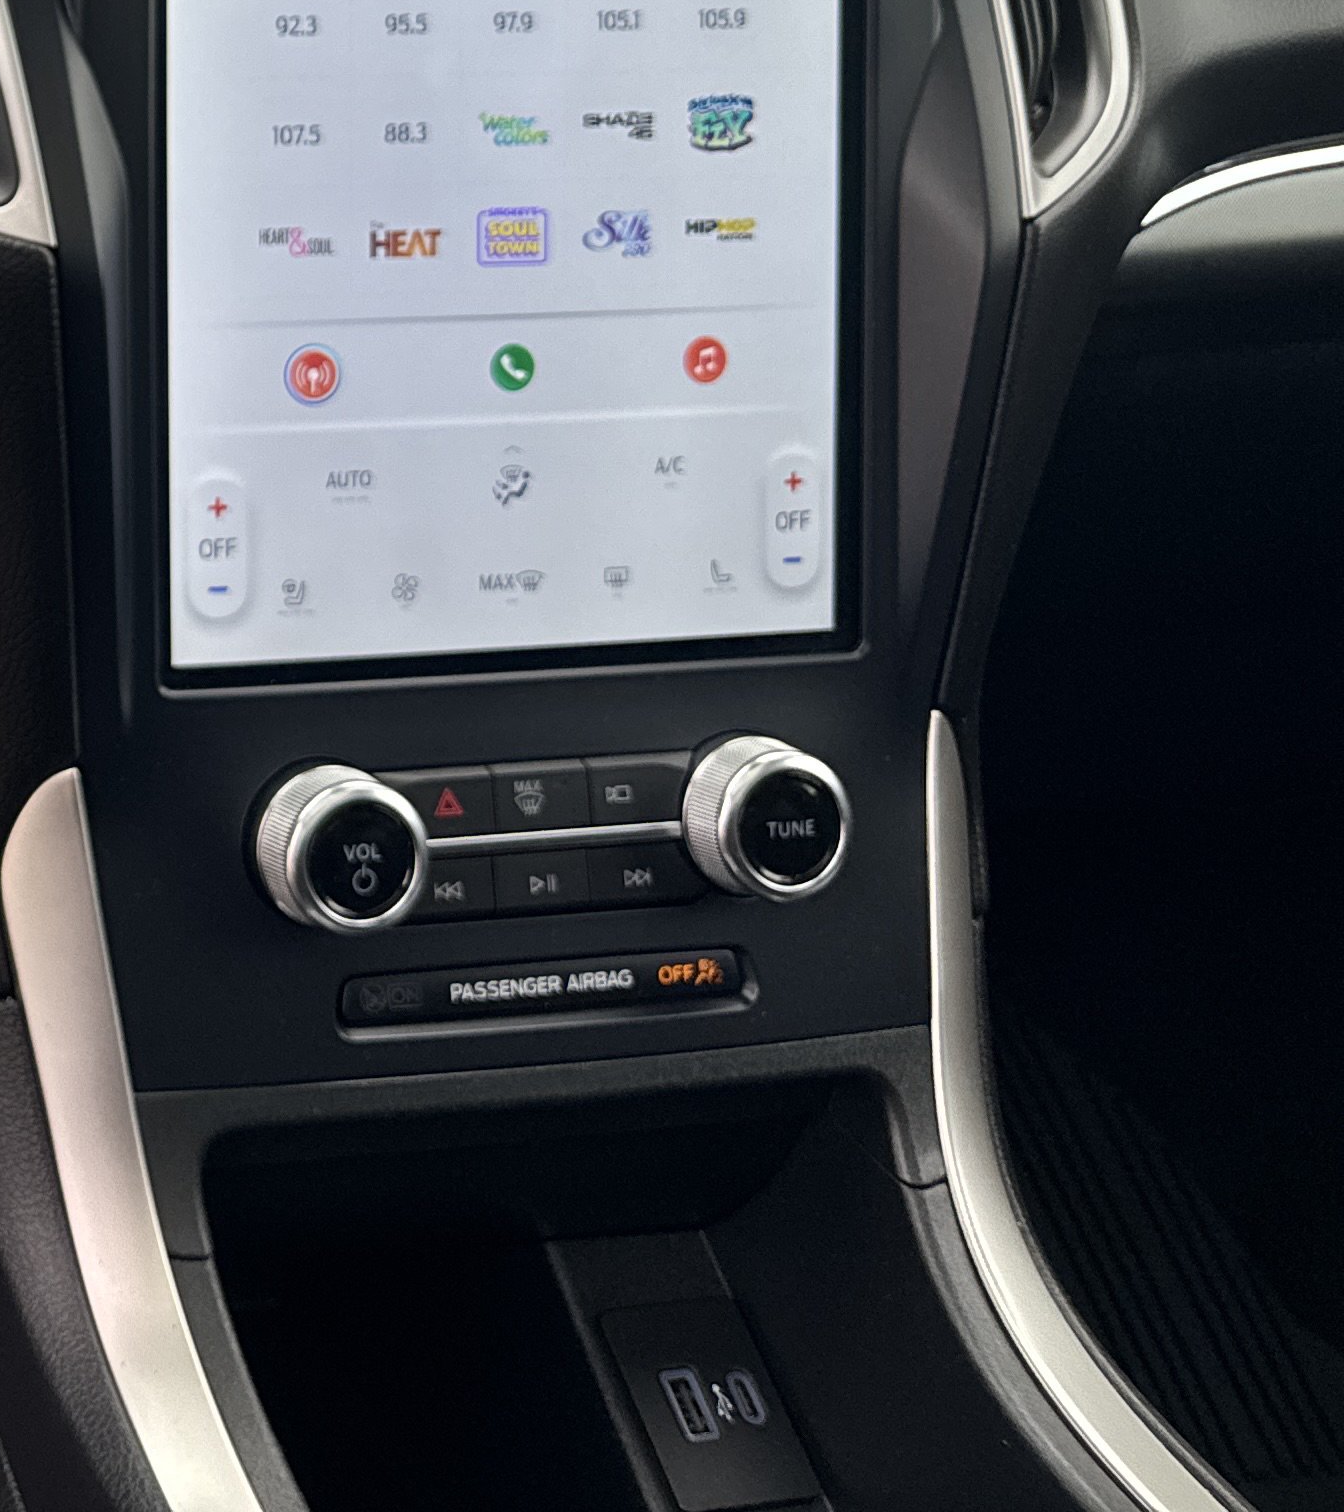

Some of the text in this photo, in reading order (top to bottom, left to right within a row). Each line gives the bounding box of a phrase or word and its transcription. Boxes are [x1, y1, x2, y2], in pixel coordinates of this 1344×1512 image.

[275, 15, 318, 38] 92.3
[384, 12, 429, 35] 95.5
[493, 10, 535, 34] 97.9
[596, 8, 642, 32] 105.1
[697, 7, 747, 30] 105.9
[272, 123, 321, 147] 107.5
[384, 121, 427, 144] 88.3
[487, 220, 540, 238] SOUL
[369, 228, 441, 258] HEAT
[487, 240, 540, 258] TOWN
[654, 456, 686, 475] A/C
[326, 469, 372, 489] AUTO
[775, 510, 810, 531] OFF
[198, 538, 237, 559] OFF
[479, 574, 513, 592] MAX
[513, 780, 543, 793] MAX
[767, 818, 816, 841] TUNE
[343, 842, 382, 864] VOL
[450, 963, 694, 1004] PASSENGER AIRBAG OFF
